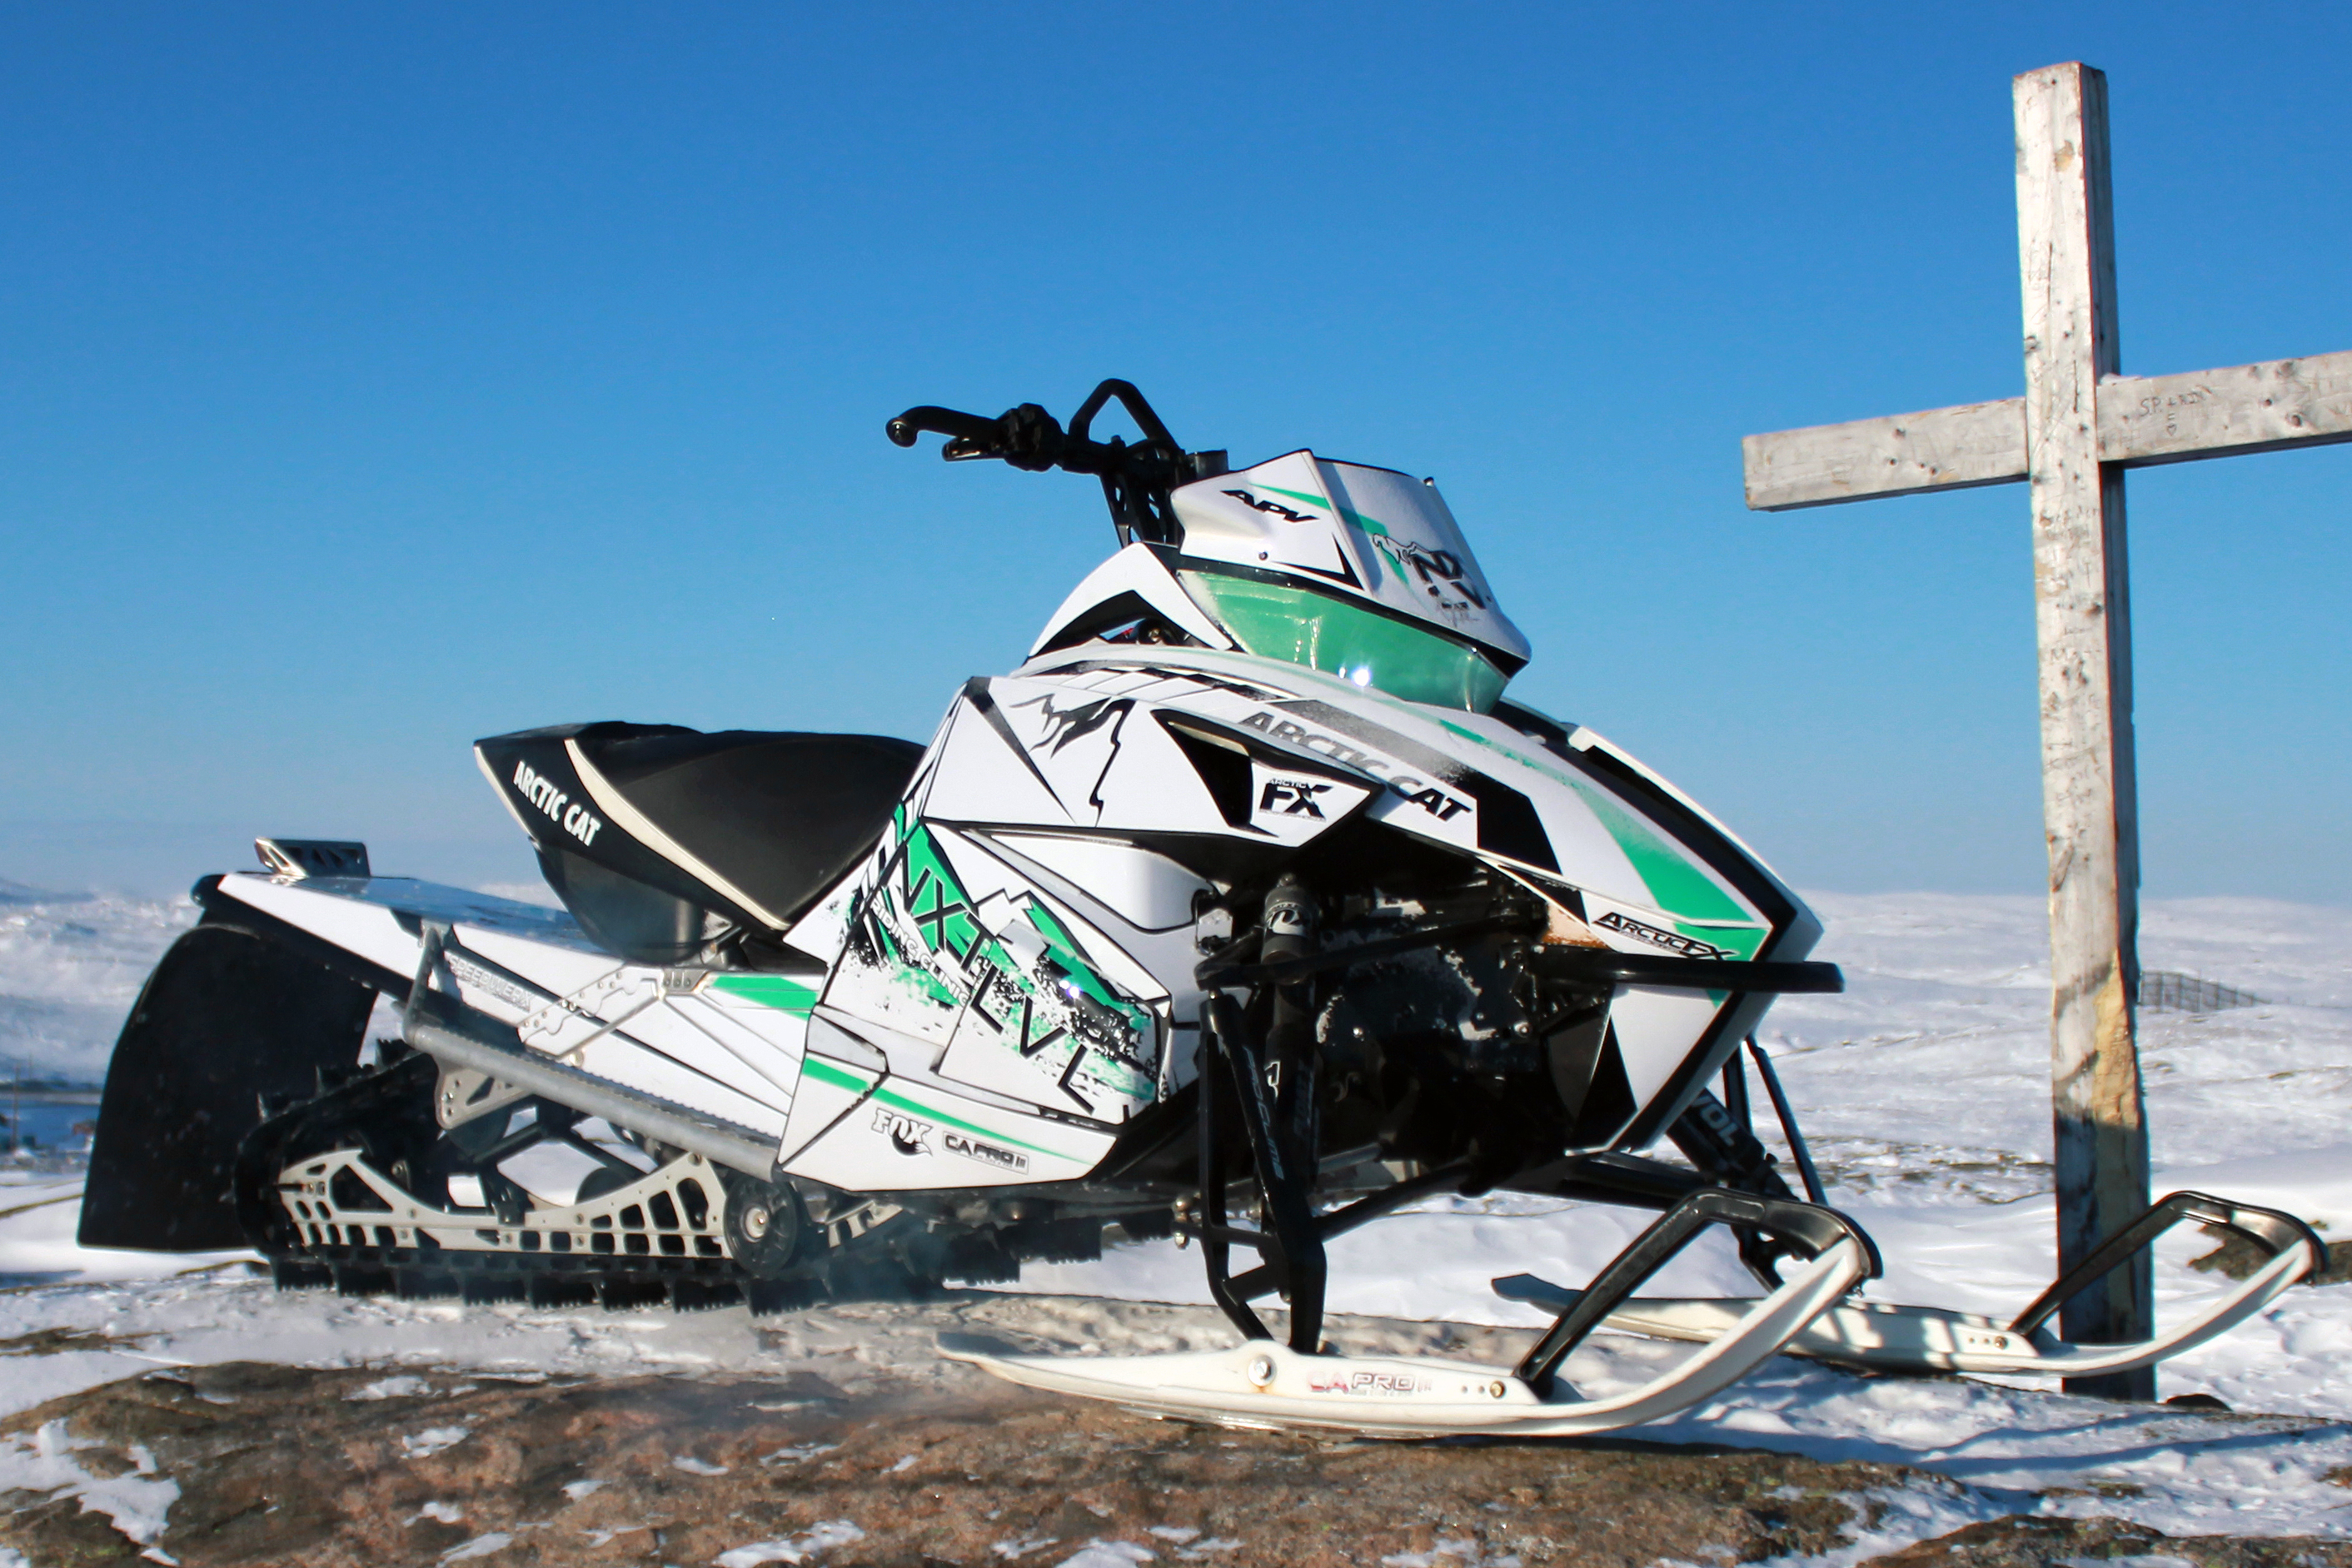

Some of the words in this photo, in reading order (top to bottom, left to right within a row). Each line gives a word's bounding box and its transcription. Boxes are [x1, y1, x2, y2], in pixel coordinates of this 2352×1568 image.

[1238, 711, 1389, 774] ARCTIC
[1388, 774, 1472, 823] CAT
[1269, 779, 1308, 789] ARCTIC
[513, 759, 567, 823] ARCTIC
[563, 803, 602, 847] CAT
[1259, 783, 1333, 818] FX
[871, 1108, 933, 1146] FOX
